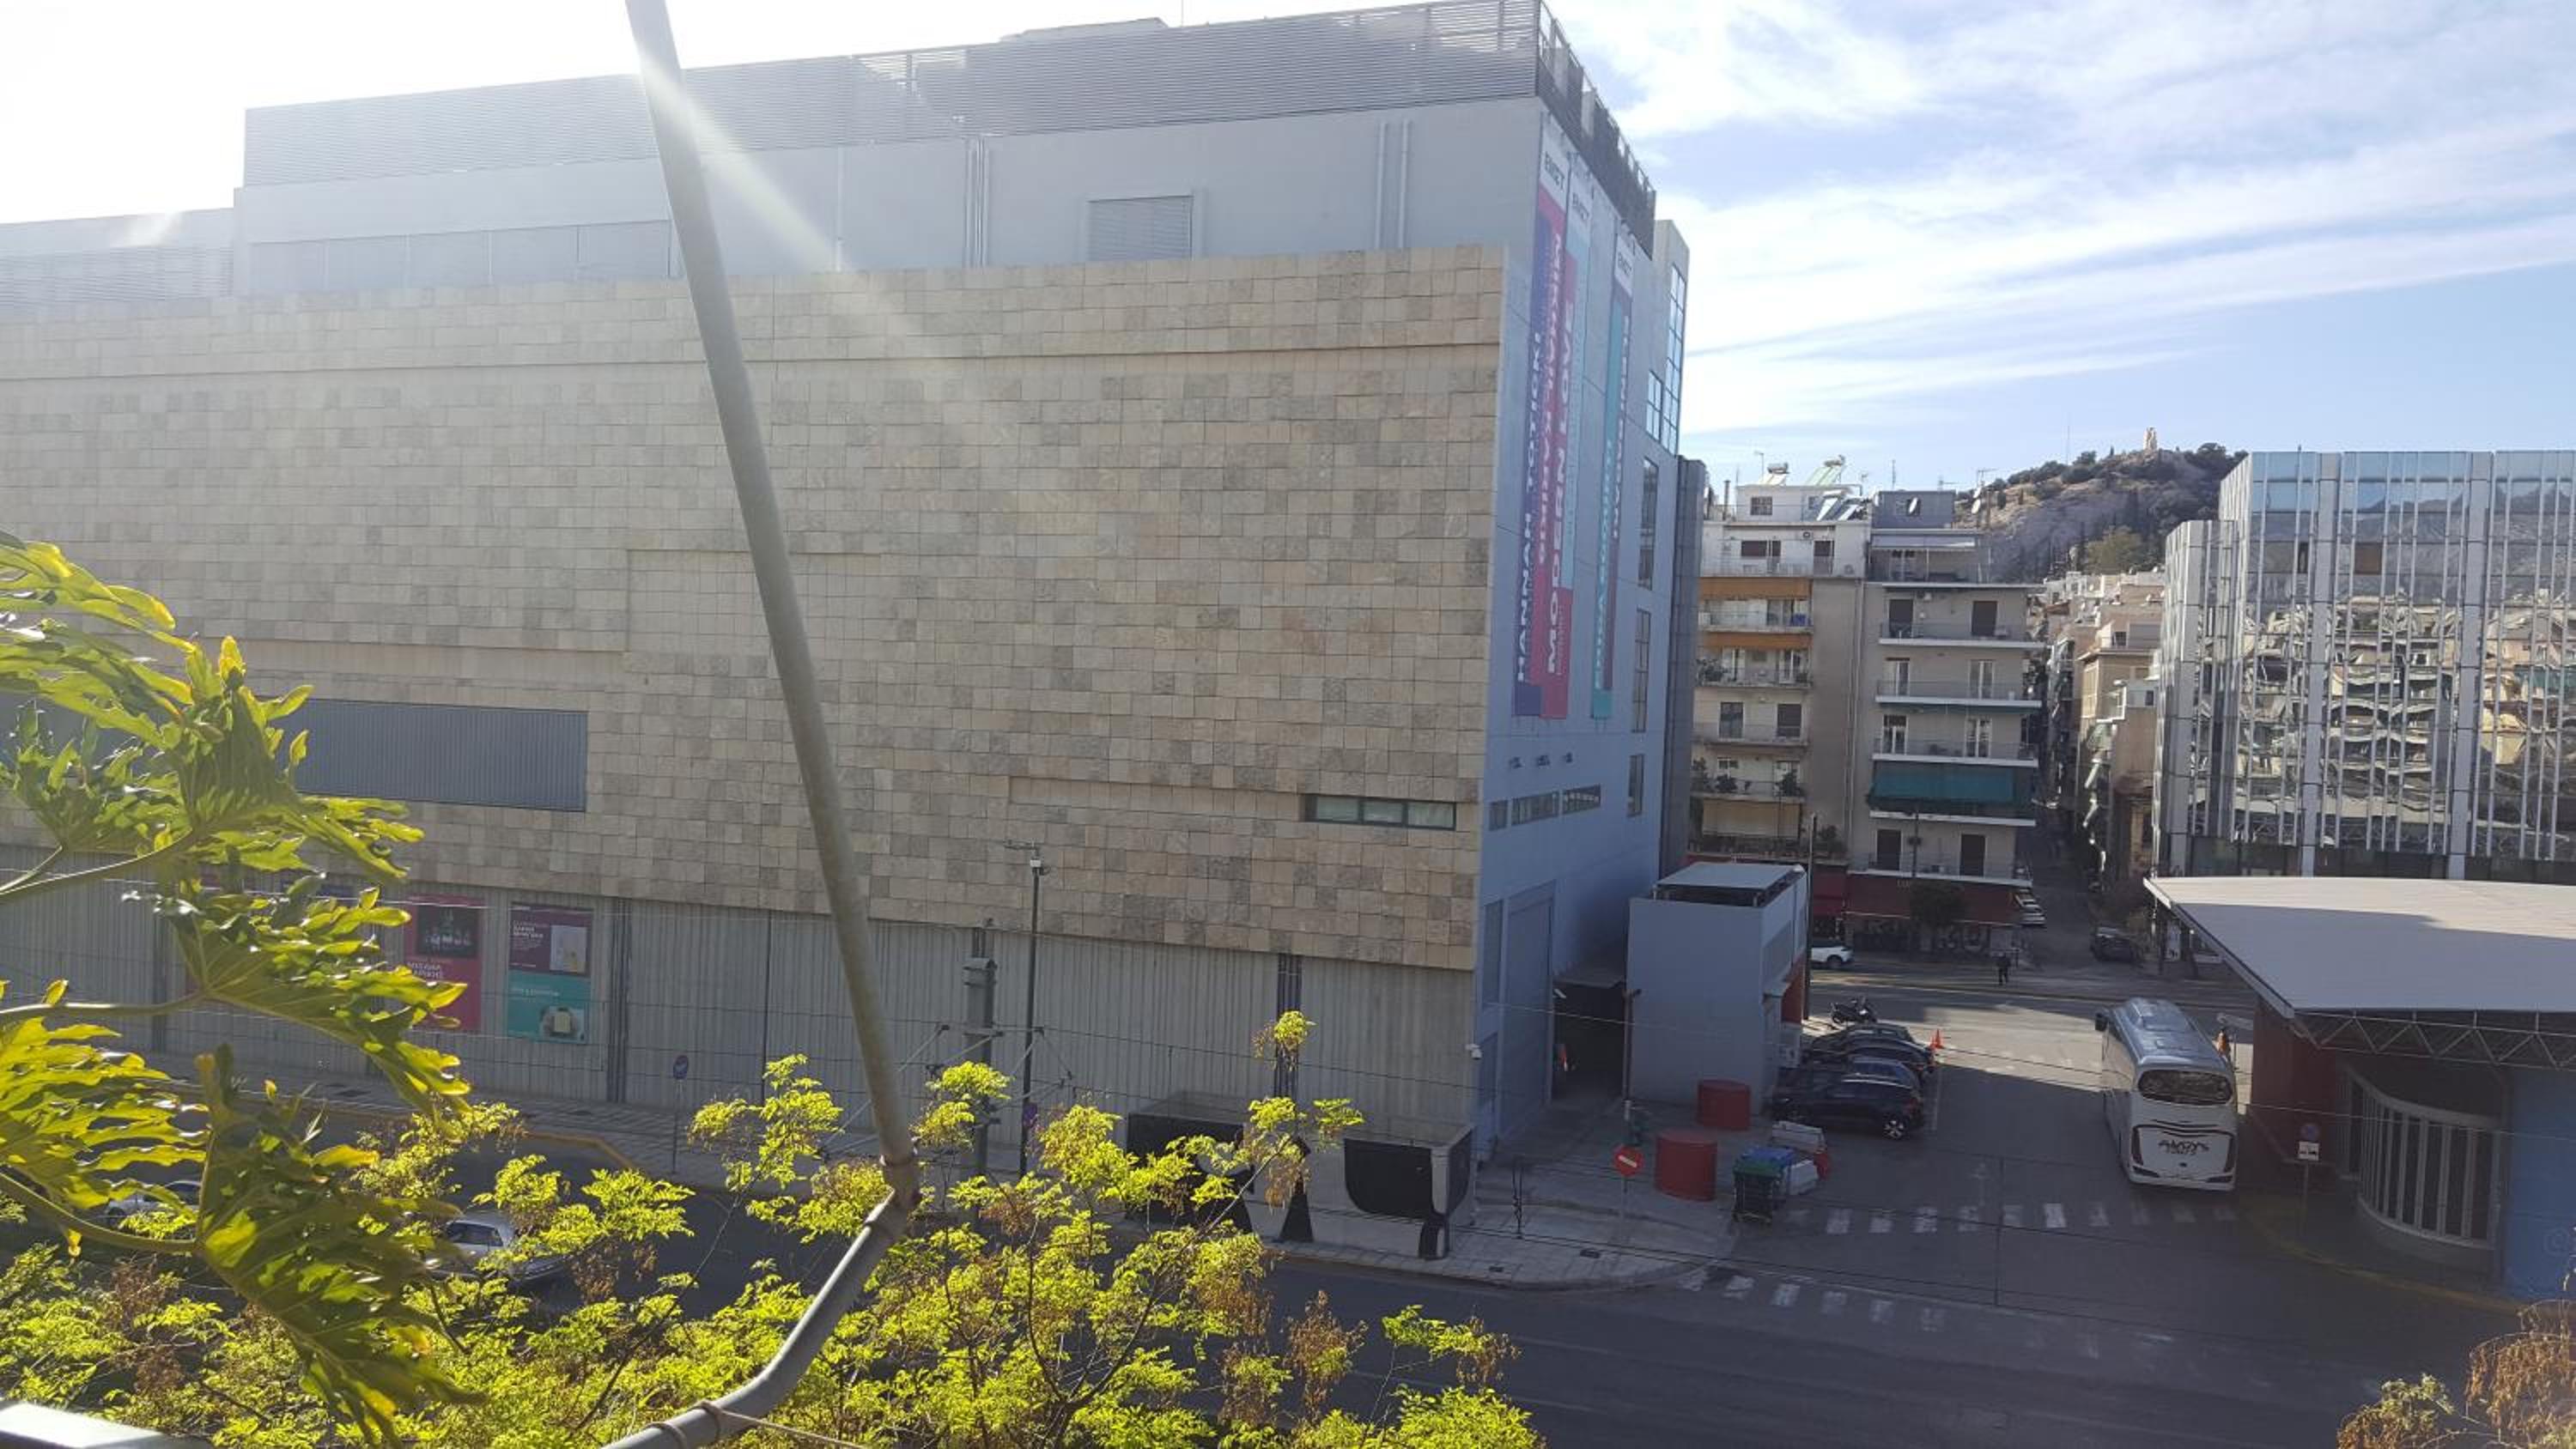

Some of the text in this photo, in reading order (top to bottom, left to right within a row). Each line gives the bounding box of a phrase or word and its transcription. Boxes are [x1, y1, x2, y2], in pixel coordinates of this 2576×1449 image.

[1517, 513, 1532, 682] HANNAH
[1548, 446, 1565, 673] MODERN
[1560, 301, 1573, 434] LOVE
